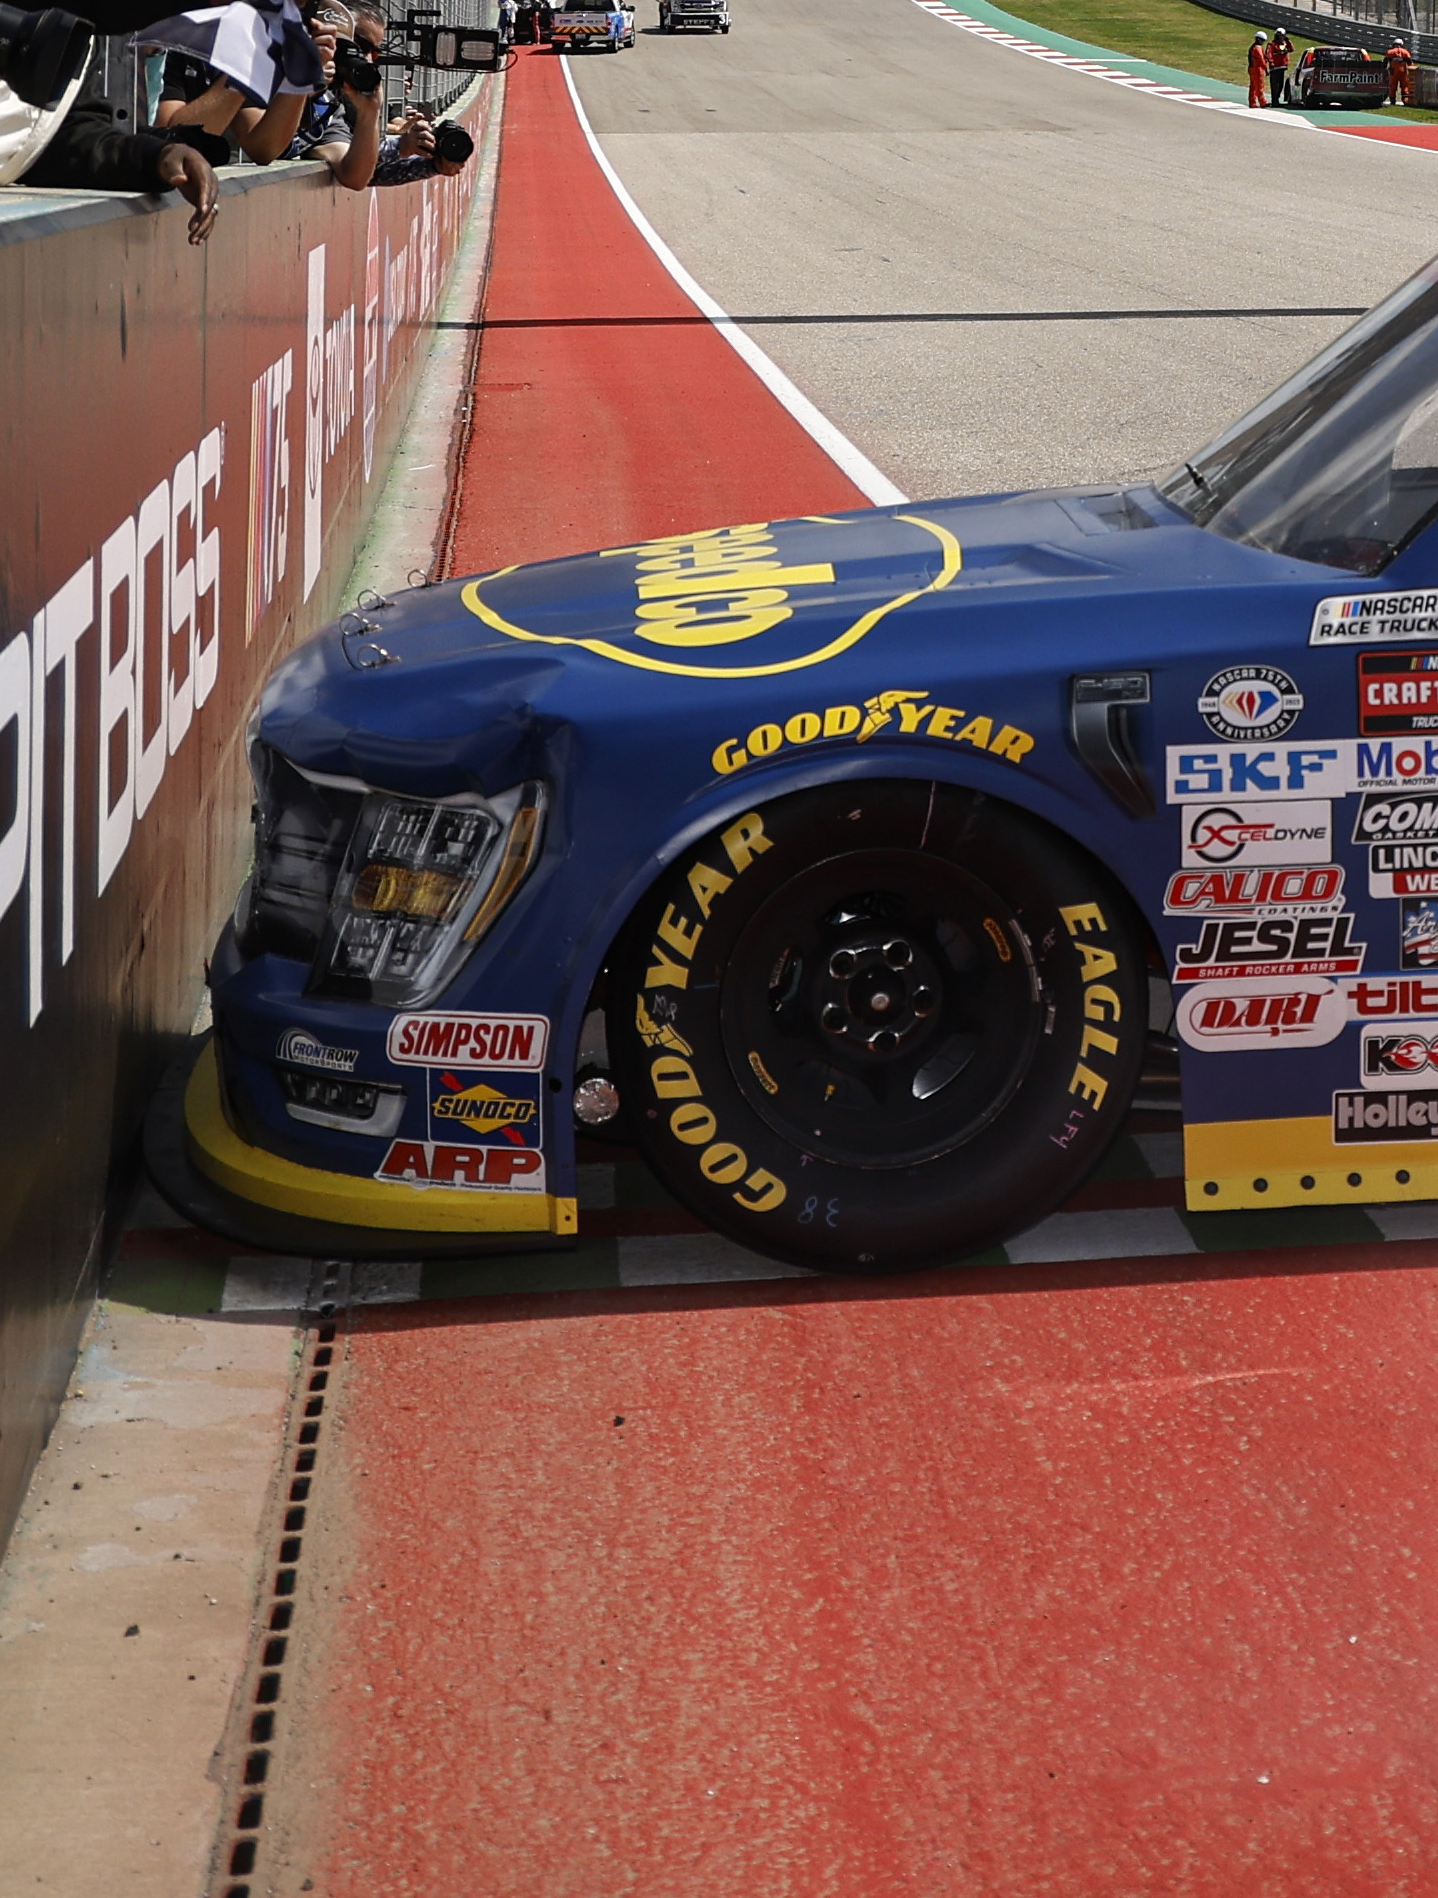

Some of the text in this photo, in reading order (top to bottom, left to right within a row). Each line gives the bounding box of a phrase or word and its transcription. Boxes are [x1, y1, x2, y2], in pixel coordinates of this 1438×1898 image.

[1319, 69, 1381, 84] FarmPaint
[1359, 595, 1438, 618] NASCAR
[1319, 621, 1370, 637] RACE
[97, 426, 222, 898] BOSS
[1212, 669, 1289, 692] NASCAR 75TH
[1211, 711, 1292, 739] ANNIVERSARY
[1174, 749, 1338, 794] SKF
[1357, 779, 1398, 788] OFFICIAL
[1401, 777, 1436, 786] MOTOR
[1187, 823, 1327, 850] XCELDYNE
[1372, 830, 1437, 840] GASKET
[1166, 868, 1342, 907] CALICO
[1257, 905, 1340, 916] COATINGS
[1178, 915, 1358, 965] JESEL
[1198, 962, 1337, 978] SHAFT ROCKER ARMS
[1058, 902, 1122, 1112] EAGLE
[1199, 990, 1324, 1029] DART
[398, 1019, 534, 1061] SIMPSON
[436, 1097, 533, 1120] SUNOCO
[381, 1141, 543, 1184] ARP
